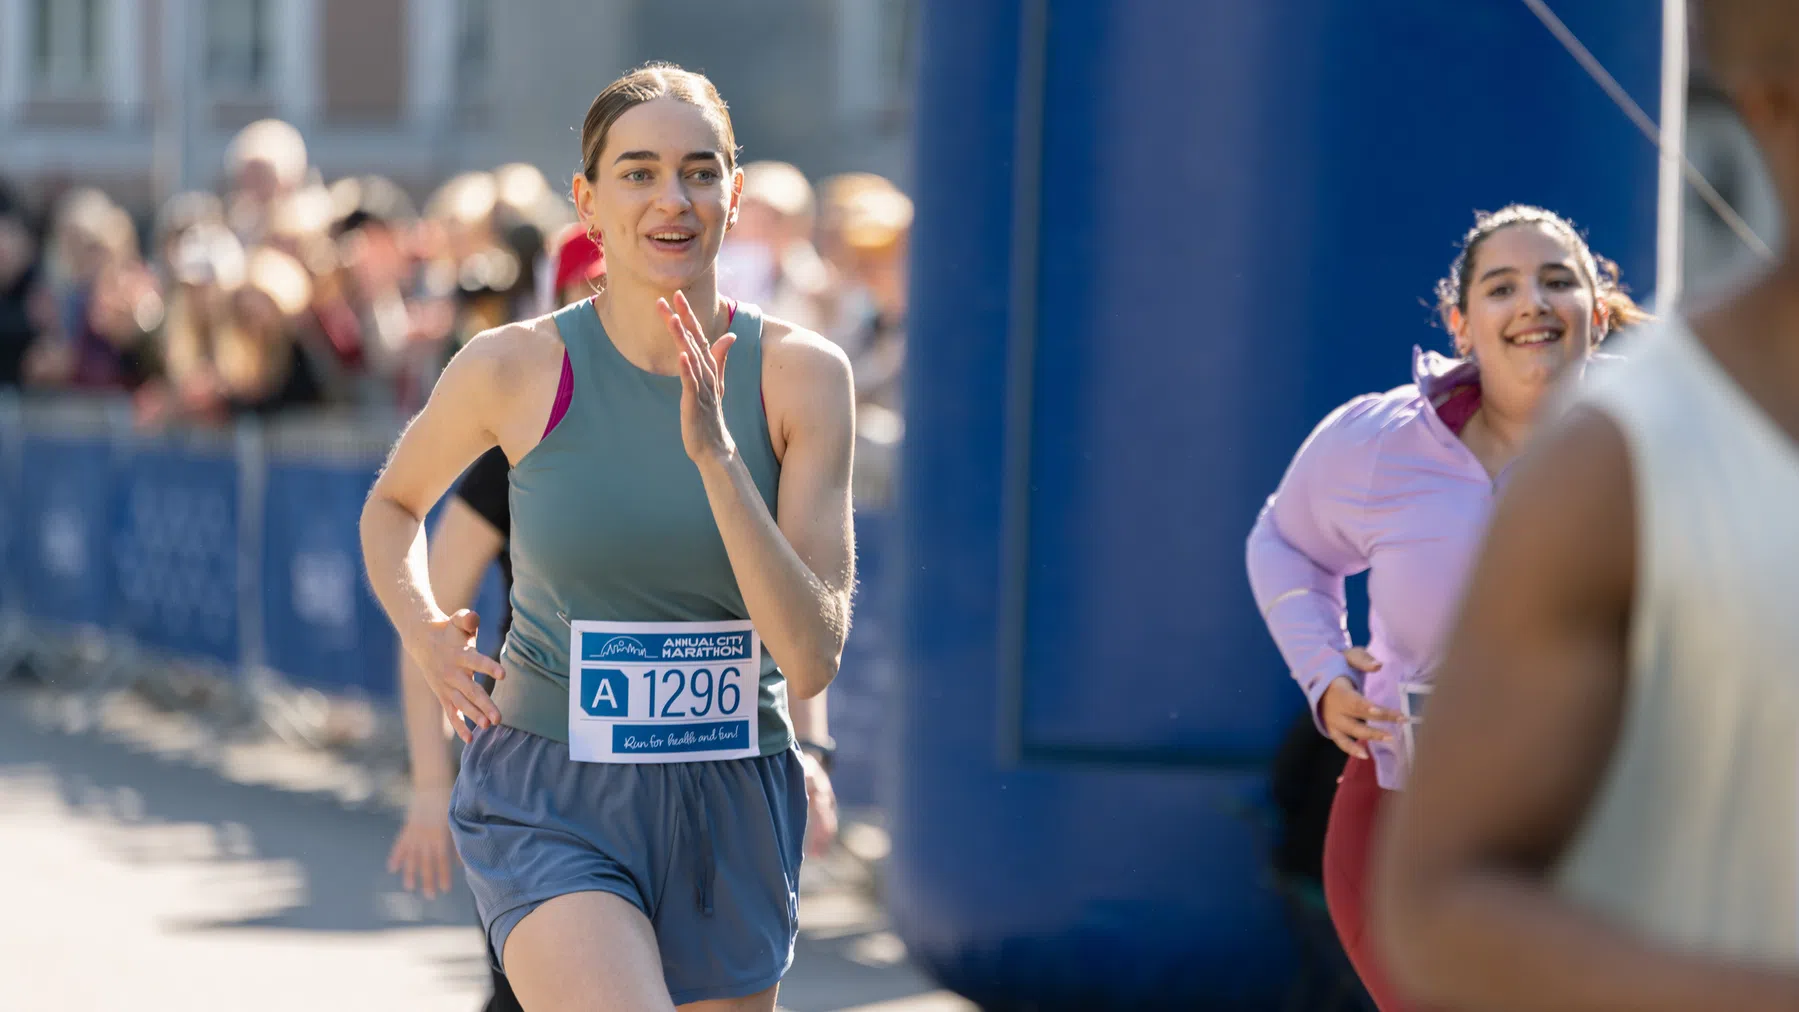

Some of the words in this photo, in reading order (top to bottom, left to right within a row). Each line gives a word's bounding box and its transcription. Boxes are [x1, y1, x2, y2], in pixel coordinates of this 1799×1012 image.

[662, 646, 743, 658] MARATHON
[663, 637, 714, 647] ANNUAL
[716, 635, 743, 646] CITY
[591, 678, 618, 709] A
[643, 666, 741, 718] 1296
[624, 737, 648, 749] Run
[649, 735, 664, 747] for
[667, 733, 697, 747] health
[698, 732, 717, 743] and
[718, 725, 739, 739] fun!
